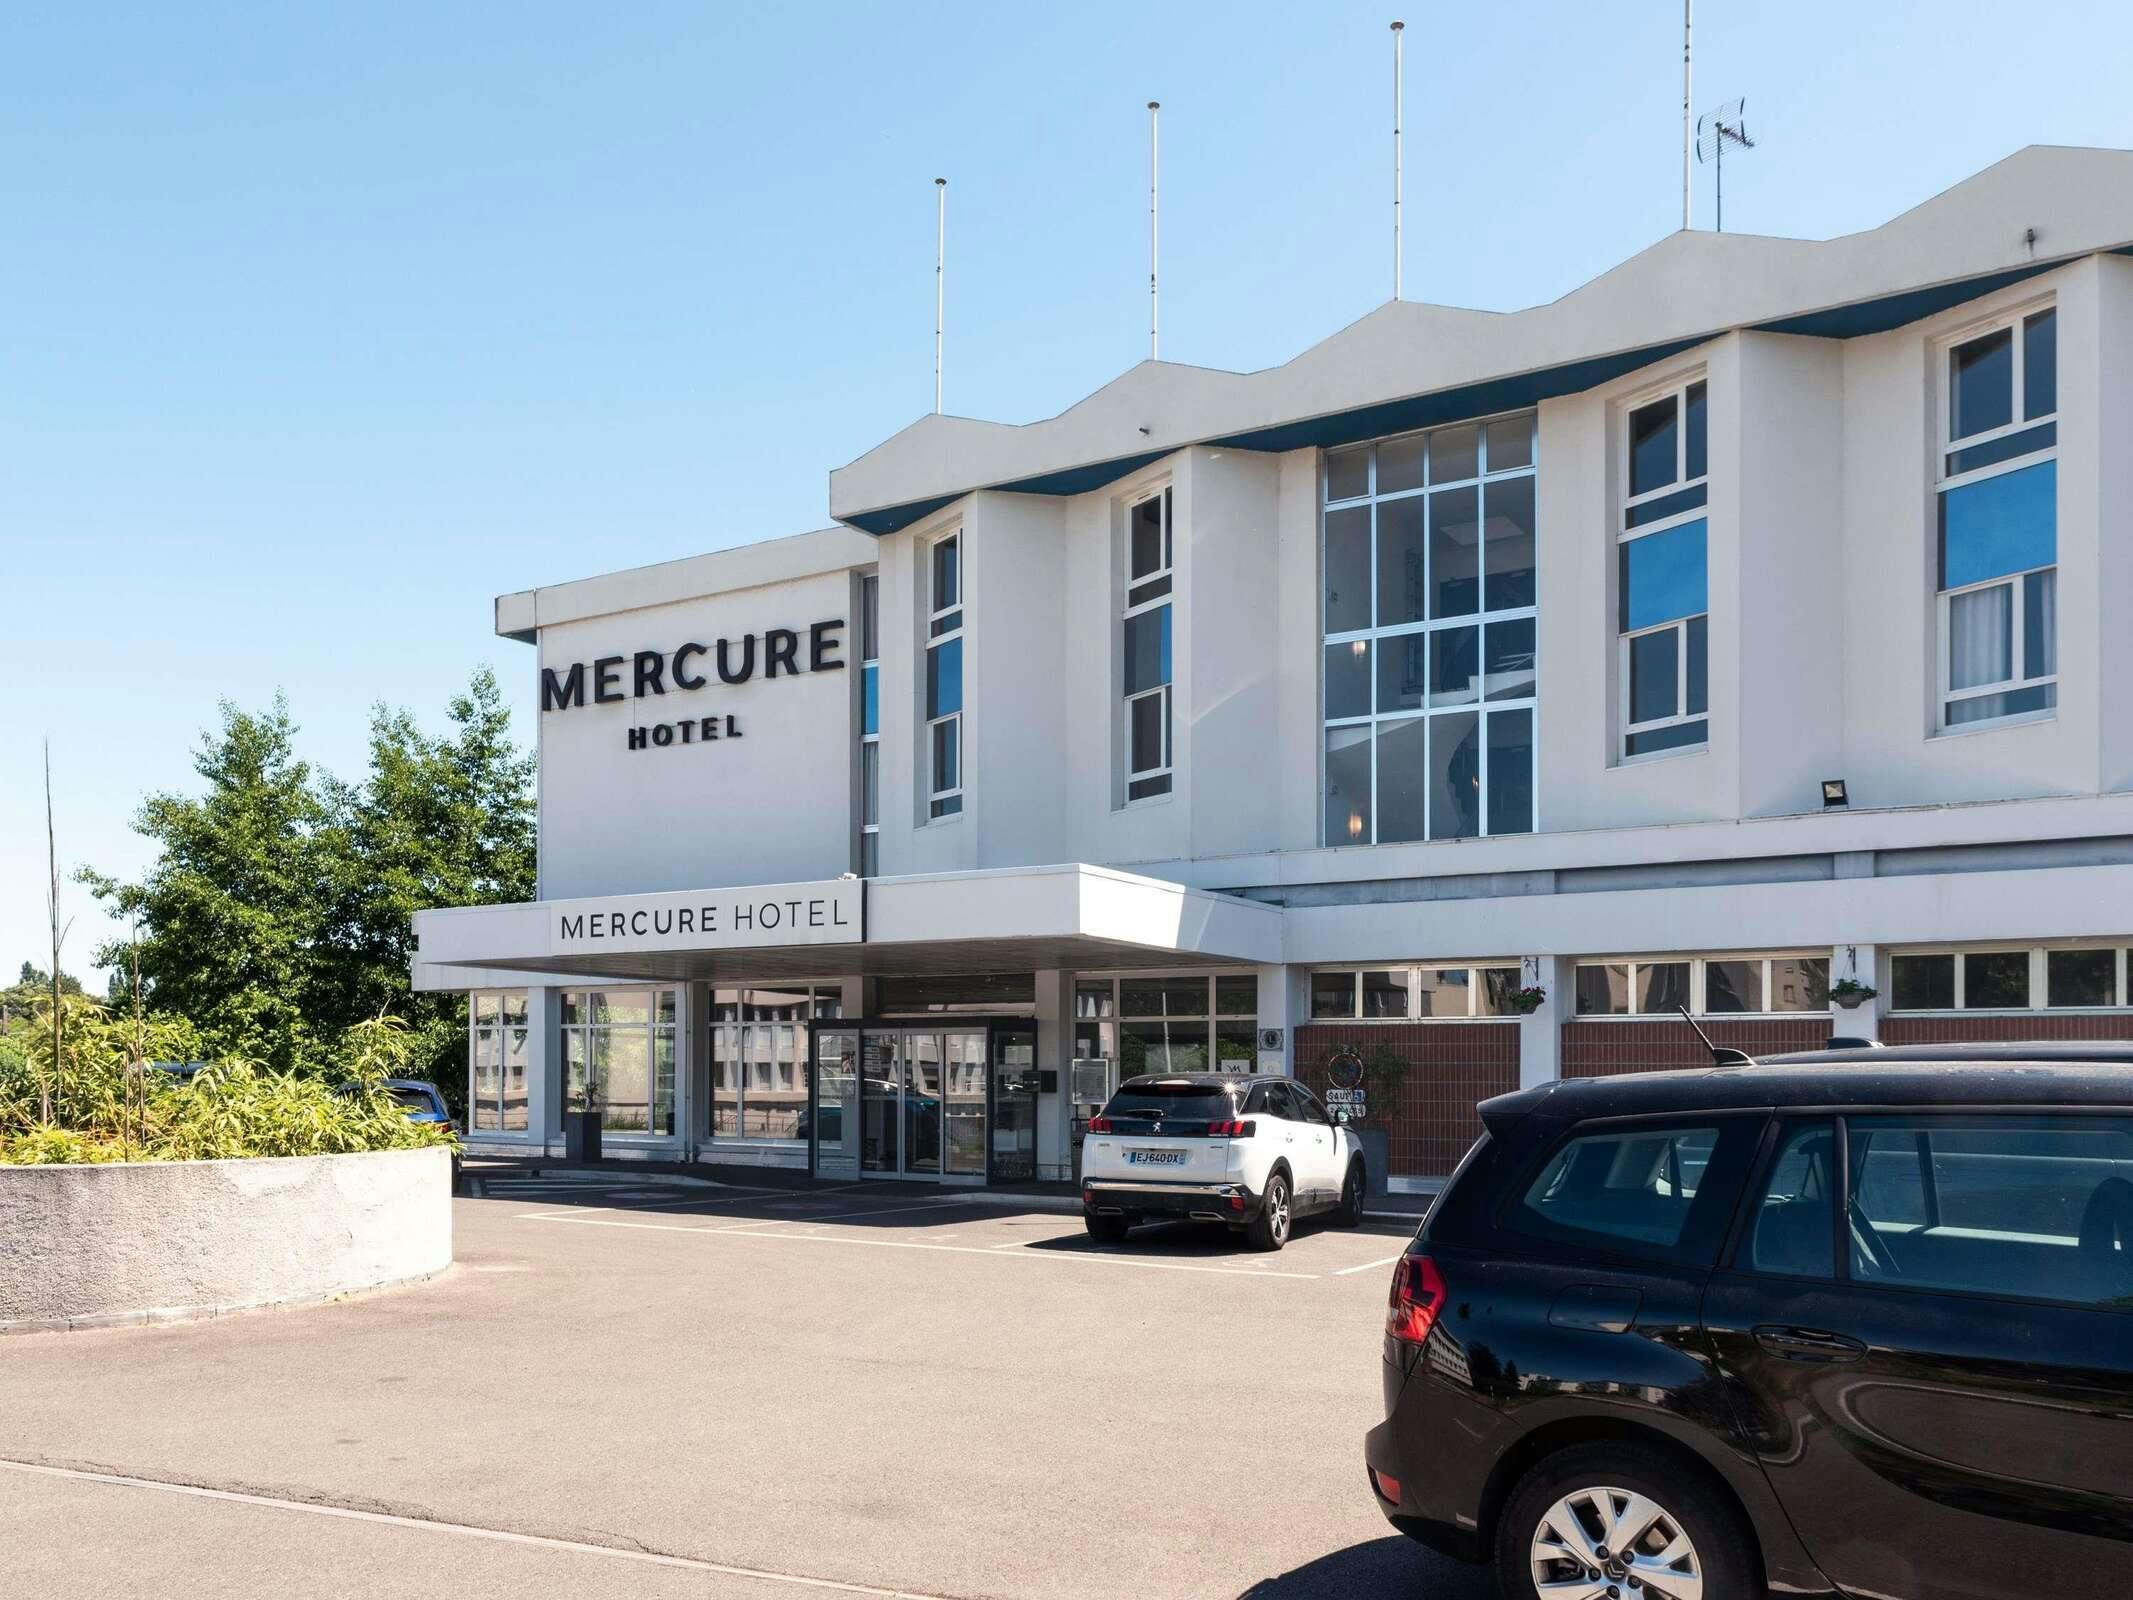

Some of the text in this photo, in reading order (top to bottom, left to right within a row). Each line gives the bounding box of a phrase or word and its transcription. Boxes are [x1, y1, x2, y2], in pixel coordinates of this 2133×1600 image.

[541, 619, 845, 711] MERCURE
[628, 714, 743, 750] HOTEL
[561, 898, 848, 939] MERCURE HOTEL
